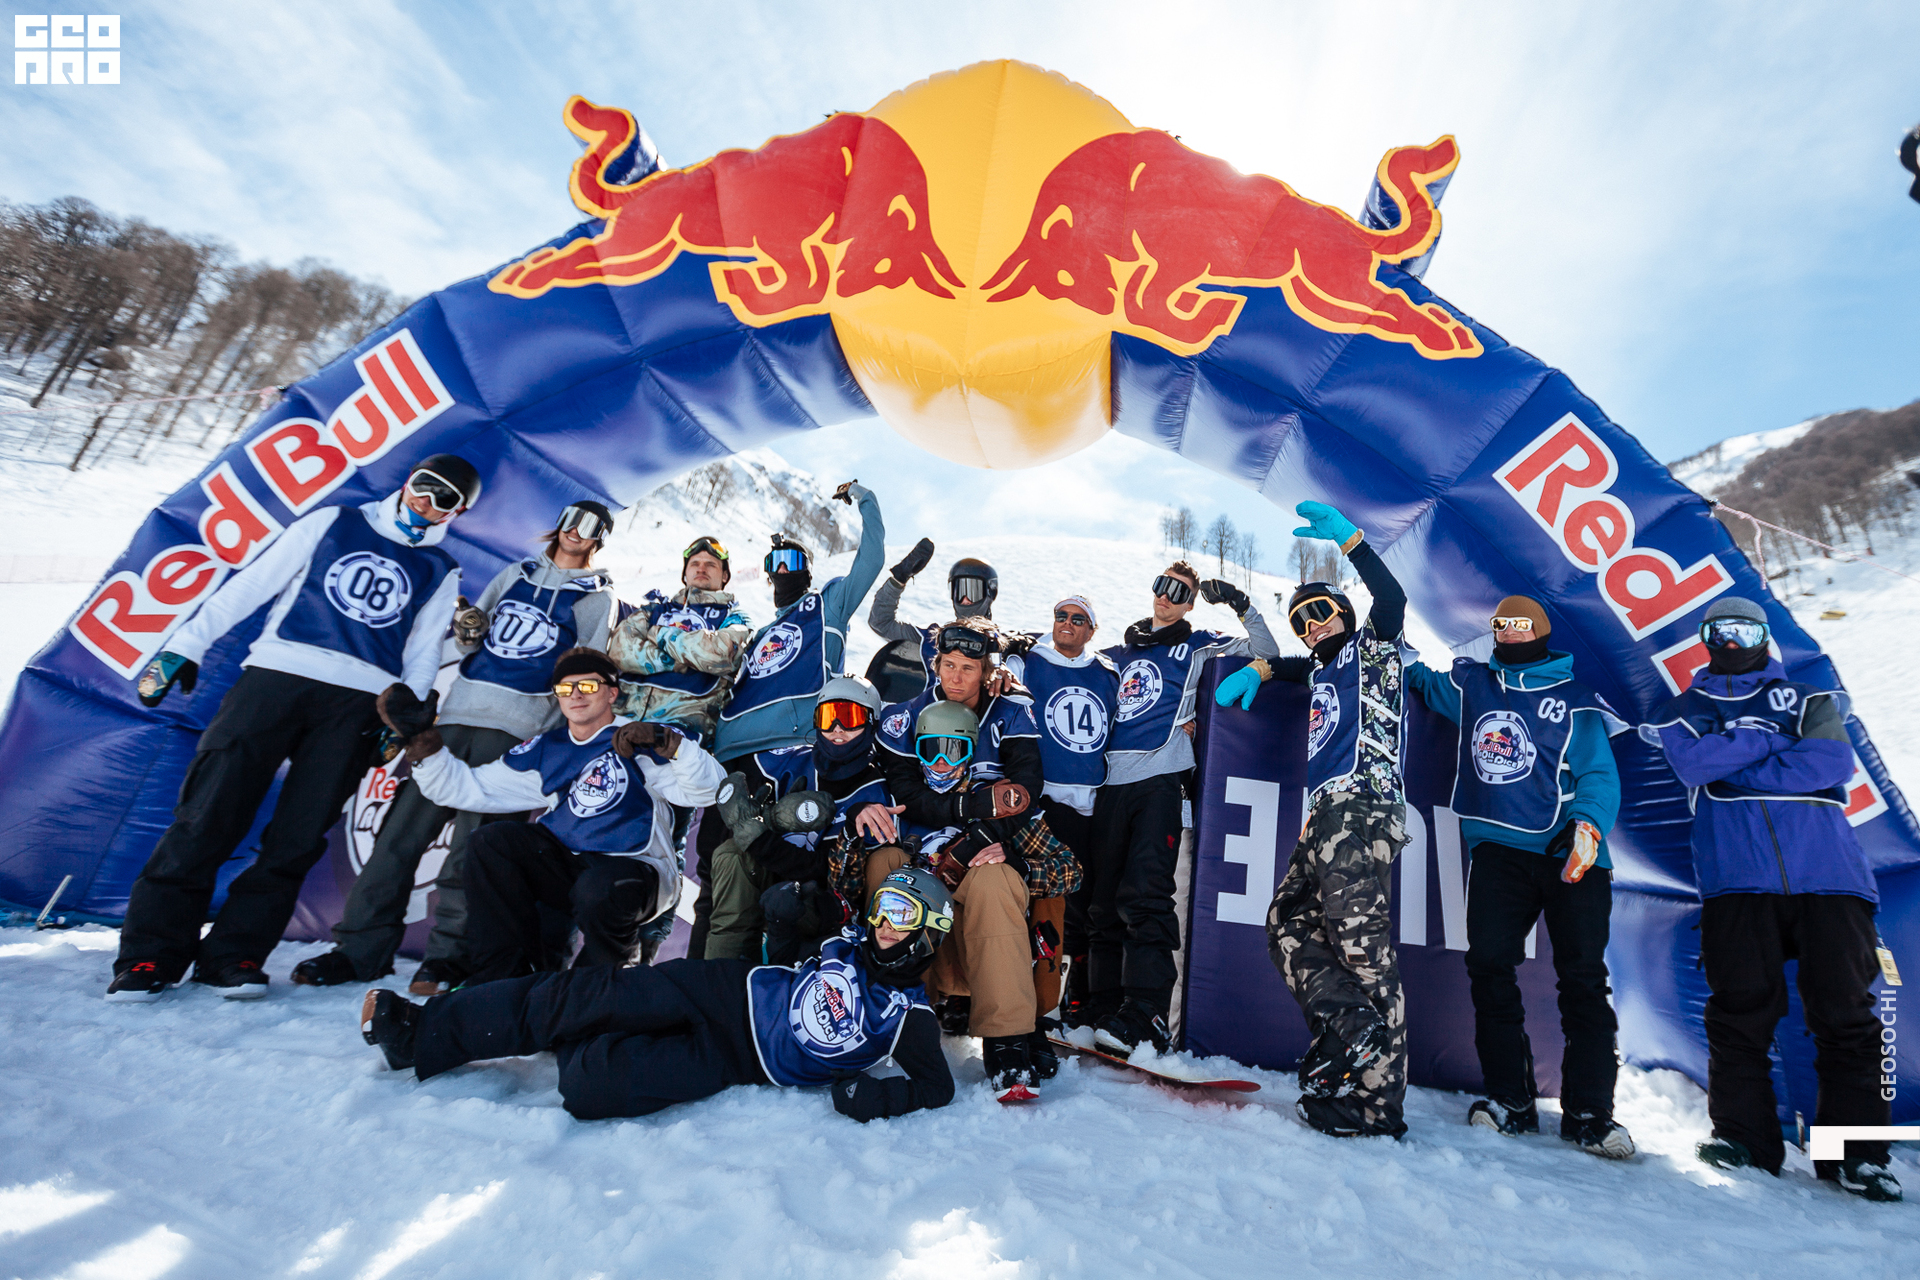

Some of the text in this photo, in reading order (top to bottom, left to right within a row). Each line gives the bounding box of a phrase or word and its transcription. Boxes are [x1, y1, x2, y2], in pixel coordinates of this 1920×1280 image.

[75, 338, 441, 670] Red Bull
[1503, 421, 1725, 632] Red
[348, 566, 394, 611] 08
[798, 596, 816, 612] 13
[498, 613, 541, 647] 07
[1168, 642, 1189, 661] 10
[1337, 640, 1355, 669] 05
[1537, 697, 1567, 723] 03
[1767, 687, 1798, 716] 02
[1063, 701, 1095, 737] 14
[1492, 743, 1514, 758] Bull
[365, 766, 399, 801] Re
[828, 992, 847, 1022] Bull
[816, 1007, 838, 1042] DICE
